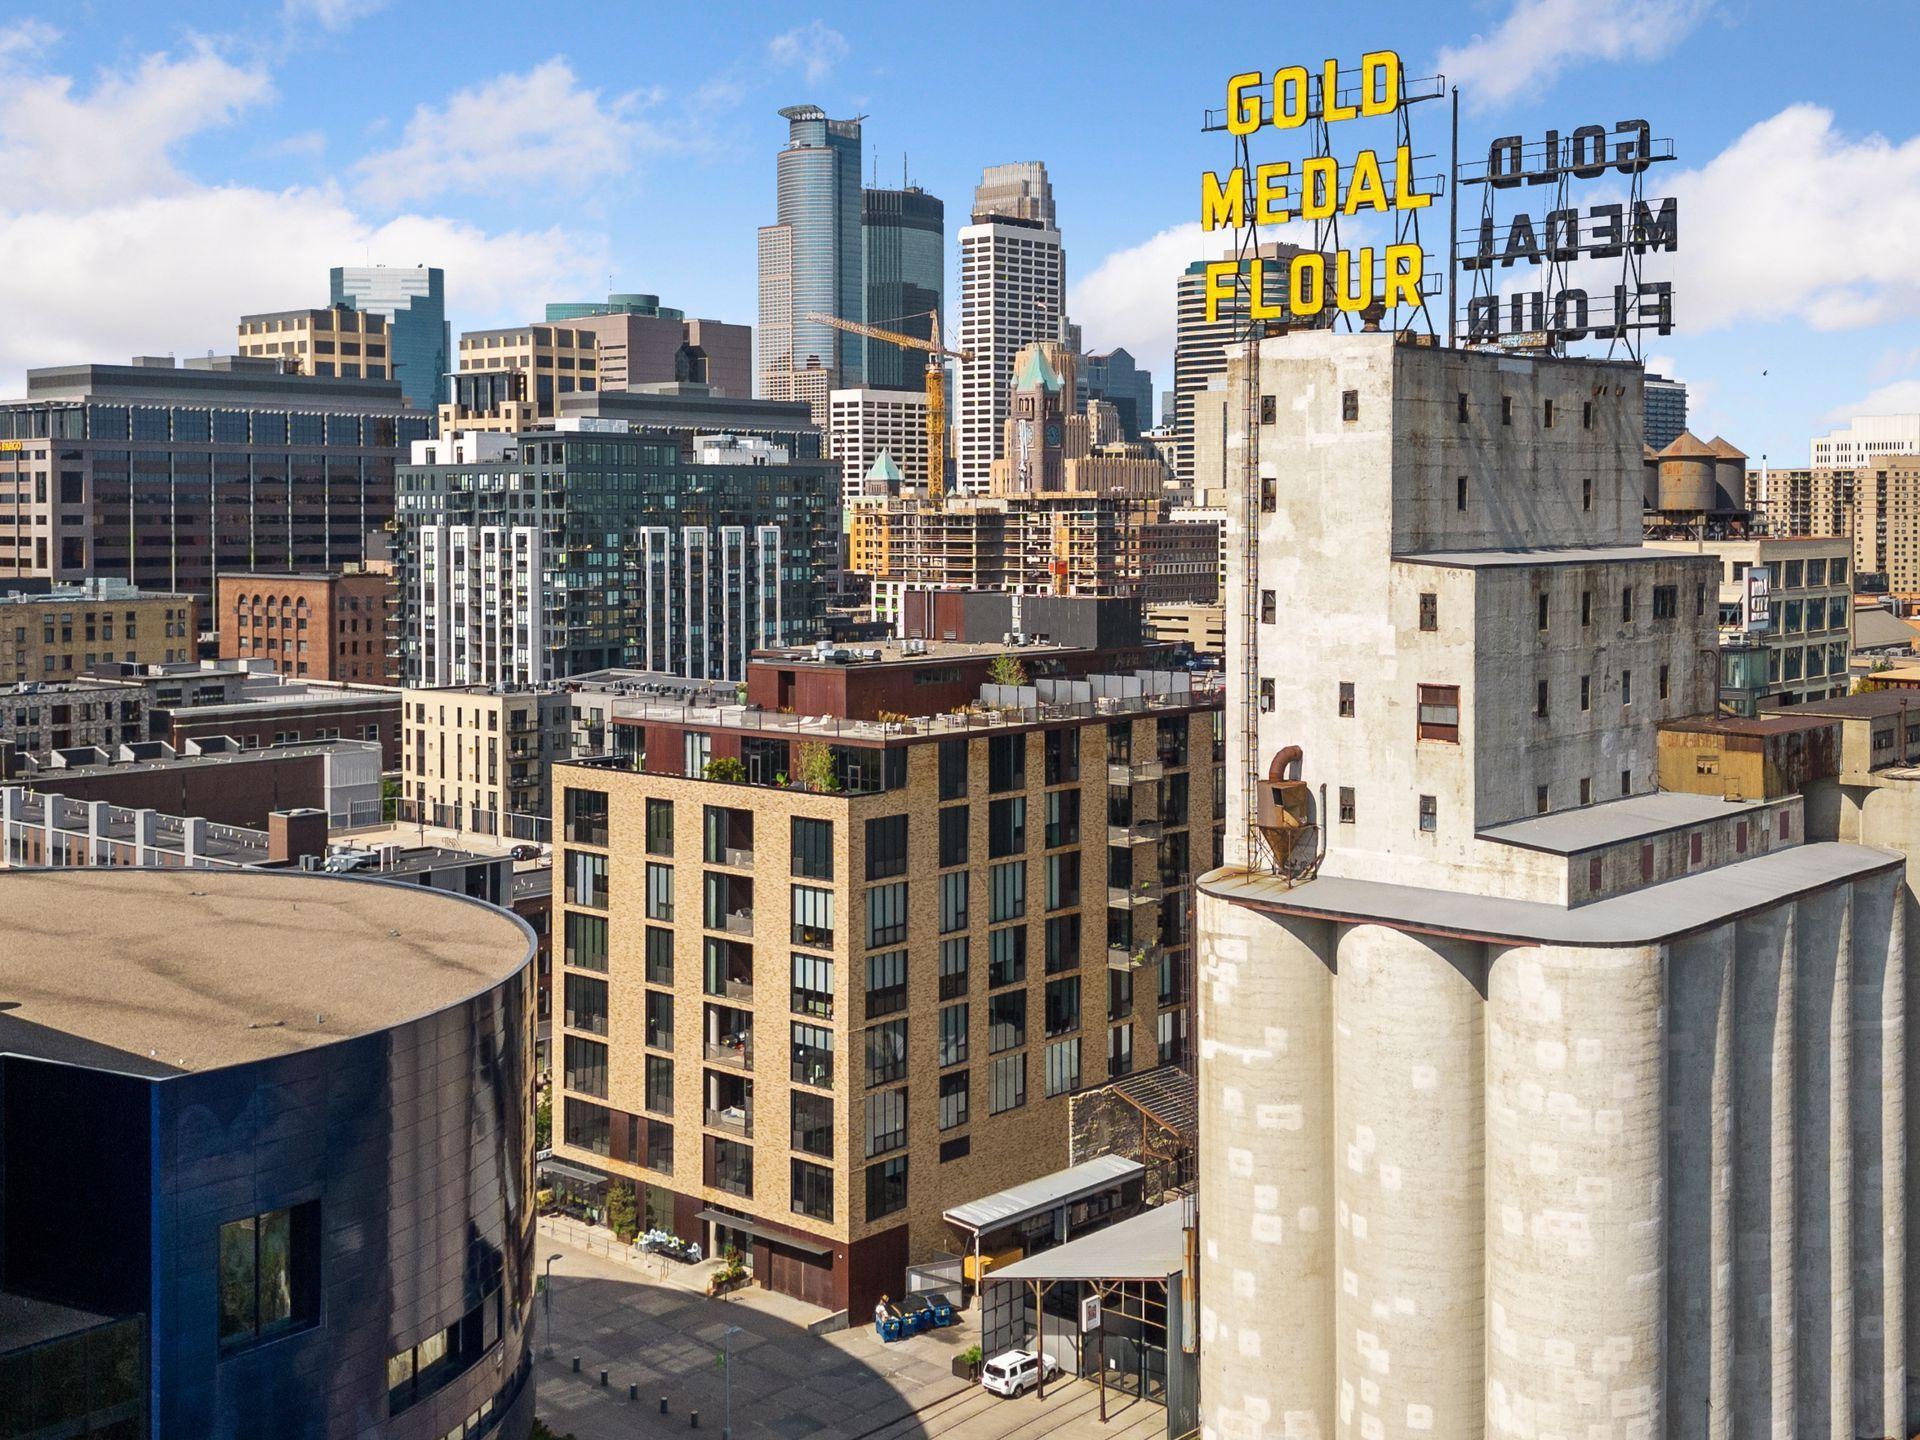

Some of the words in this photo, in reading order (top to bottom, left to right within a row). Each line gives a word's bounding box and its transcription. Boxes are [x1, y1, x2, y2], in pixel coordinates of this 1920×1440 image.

[1227, 50, 1400, 135] GOLD
[1202, 145, 1432, 232] MEDAL
[1205, 243, 1424, 323] FLOUR
